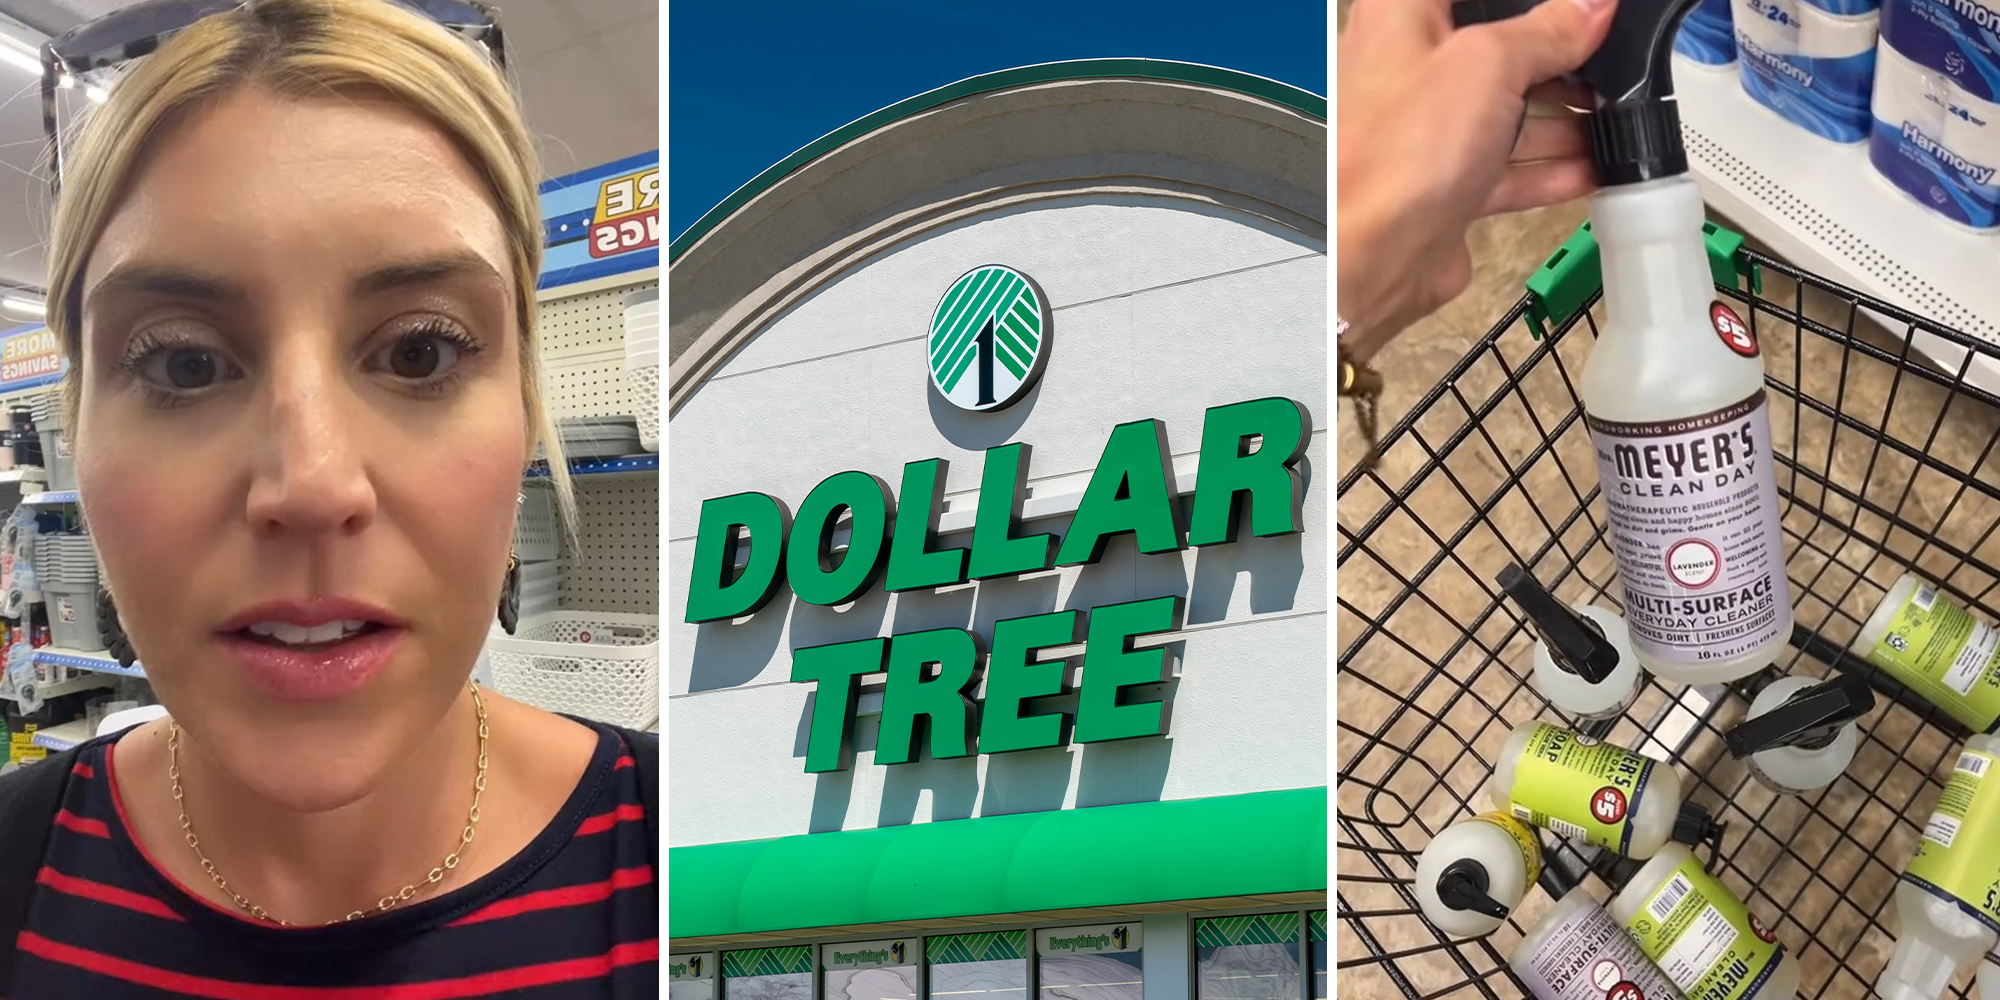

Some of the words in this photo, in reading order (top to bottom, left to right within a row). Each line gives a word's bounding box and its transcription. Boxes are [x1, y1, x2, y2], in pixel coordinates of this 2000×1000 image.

[1767, 5, 1789, 26] 24
[1902, 120, 1996, 186] Harmony
[1717, 315, 1751, 348] $5
[1668, 403, 1750, 432] HOMEKEEPING
[1614, 420, 1755, 479] MEYER'S
[1620, 479, 1704, 498] CLEAN
[1715, 460, 1756, 488] DAY
[685, 396, 1309, 624] DOLLAR
[1672, 559, 1715, 572] LAVENDER
[1624, 574, 1772, 617] MULTI-SURFACE
[1627, 603, 1698, 629] EVERYDAY
[1704, 593, 1774, 627] CLEANER
[1666, 633, 1690, 643] DIRT
[1706, 624, 1745, 641] FRESHENS
[1746, 608, 1776, 631] SURFACES
[1698, 650, 1711, 660] 16
[790, 595, 1186, 774] TREE
[1545, 729, 1570, 763] SOAP
[1604, 758, 1619, 782] DAY
[1613, 752, 1642, 788] ER'S
[1594, 791, 1617, 818] $5
[834, 949, 889, 967] Everything's
[1049, 933, 1110, 952] Everything's
[1544, 944, 1582, 984] CLEANER
[1703, 949, 1736, 985] CLEAN
